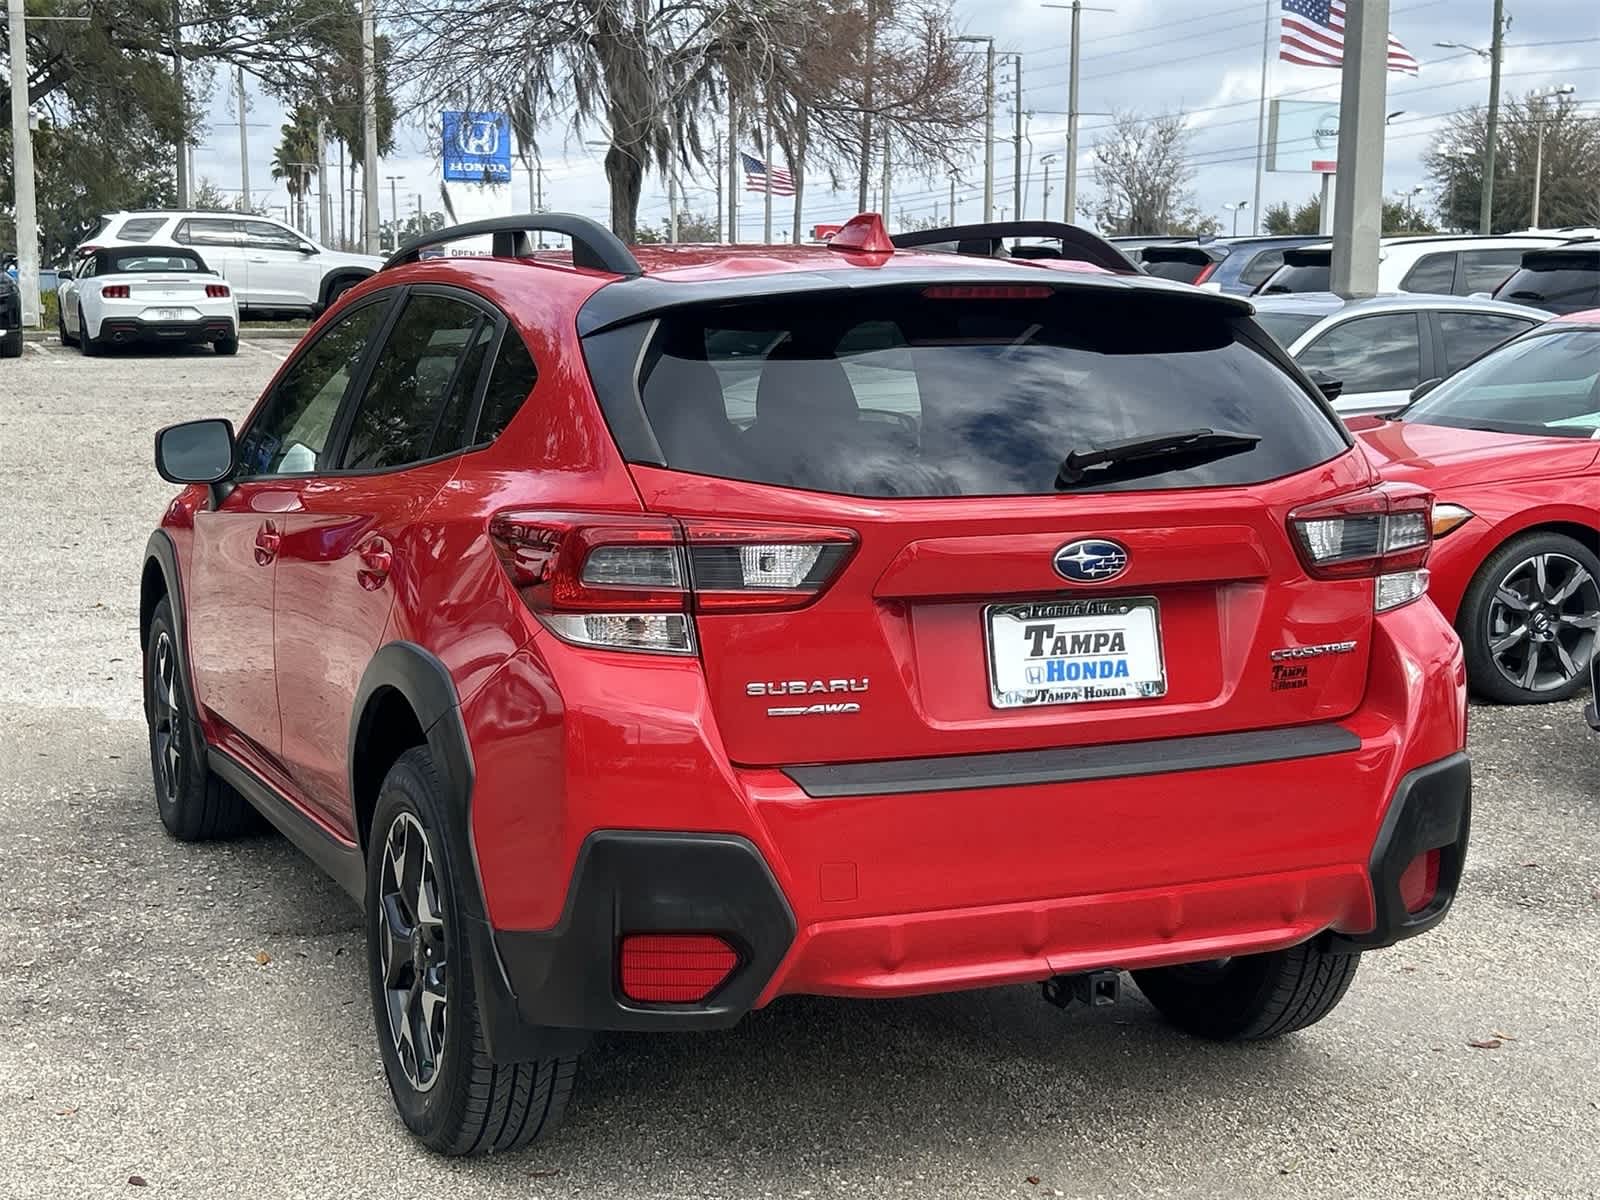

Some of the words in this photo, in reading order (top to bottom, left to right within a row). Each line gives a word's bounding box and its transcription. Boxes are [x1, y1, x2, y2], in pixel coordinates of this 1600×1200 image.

[449, 162, 509, 172] HONDA
[451, 249, 476, 257] OPEN
[1024, 624, 1126, 657] TAMPA
[1271, 641, 1357, 660] CROSSTREK
[1046, 660, 1129, 682] HONDA
[1272, 665, 1308, 680] TAMPA
[746, 678, 869, 696] SUBARU
[1038, 690, 1079, 704] TAMPA
[1084, 686, 1127, 700] HONDA
[807, 702, 860, 714] AWD
